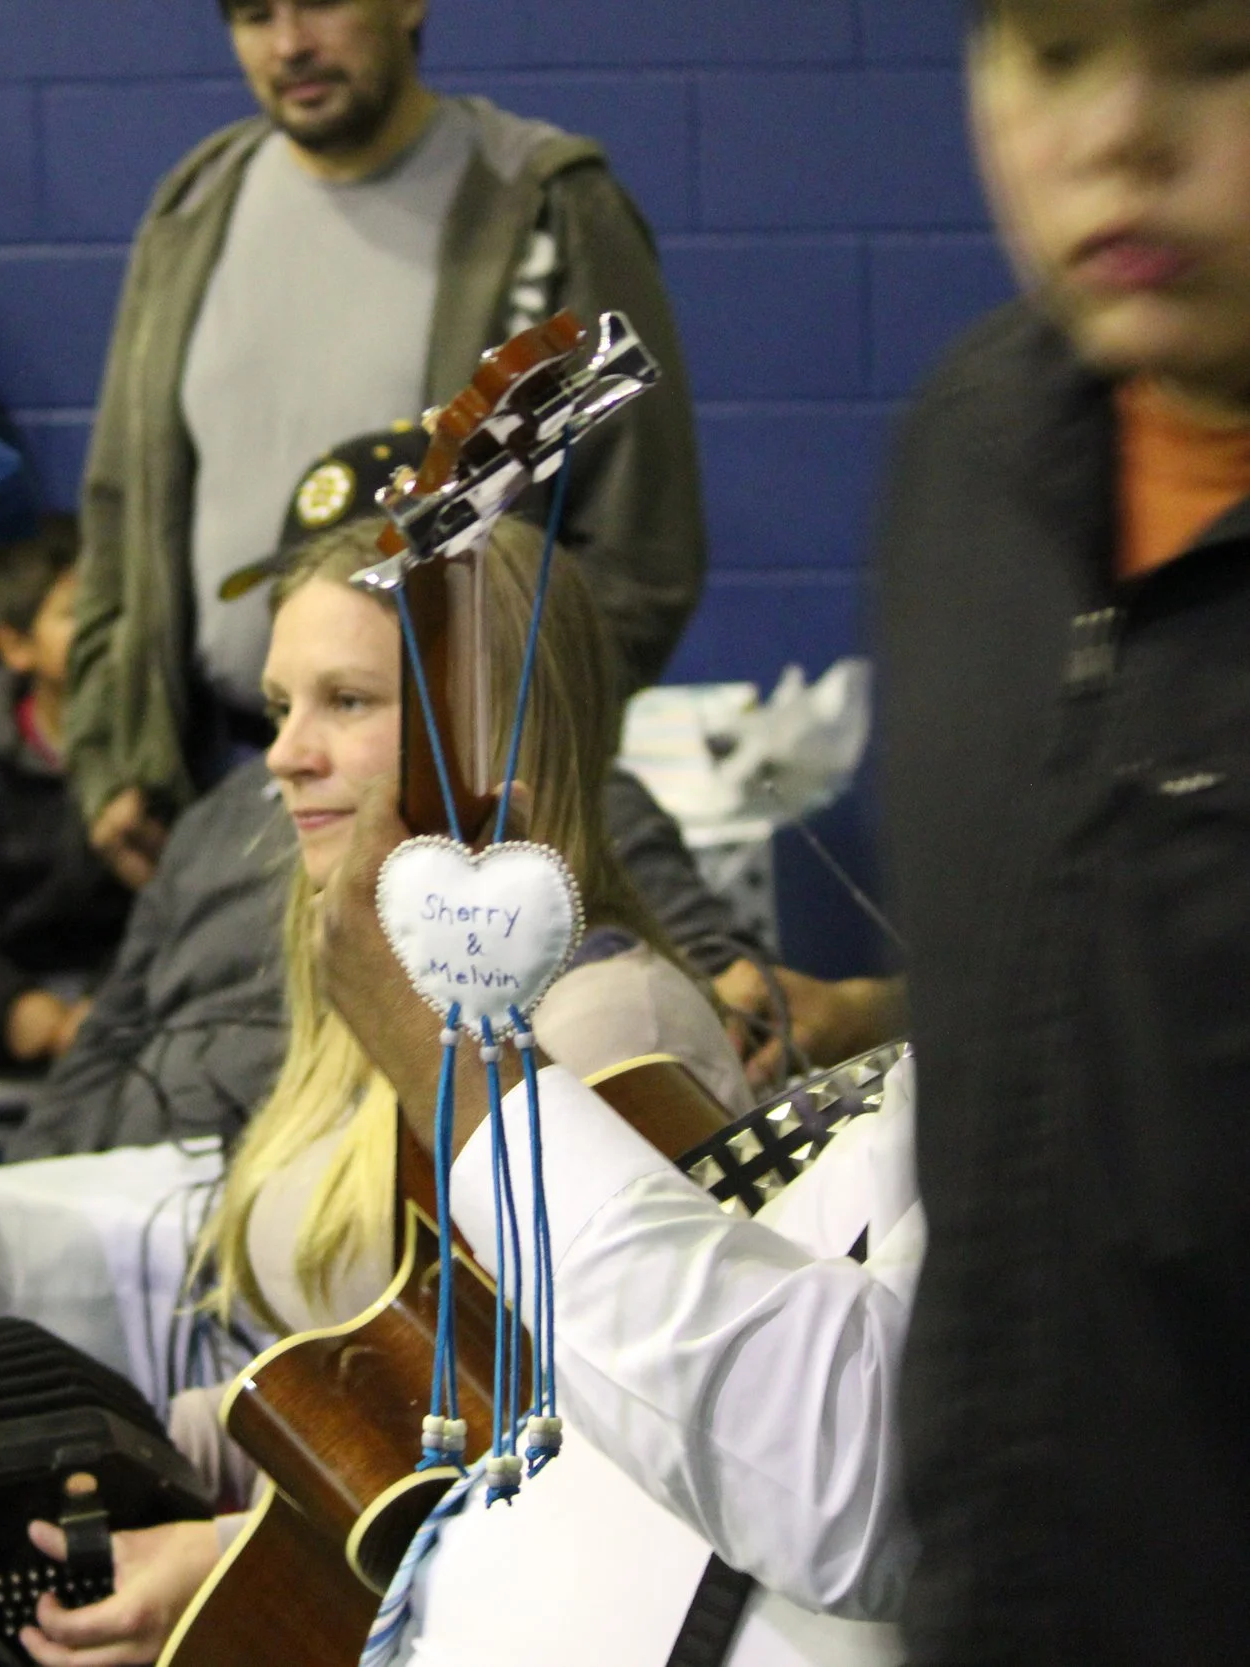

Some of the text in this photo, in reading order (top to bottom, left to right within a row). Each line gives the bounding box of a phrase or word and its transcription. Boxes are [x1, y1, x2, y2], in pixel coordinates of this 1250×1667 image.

[421, 893, 521, 938] Sherry
[466, 932, 483, 956] &
[429, 958, 520, 988] Melvin
